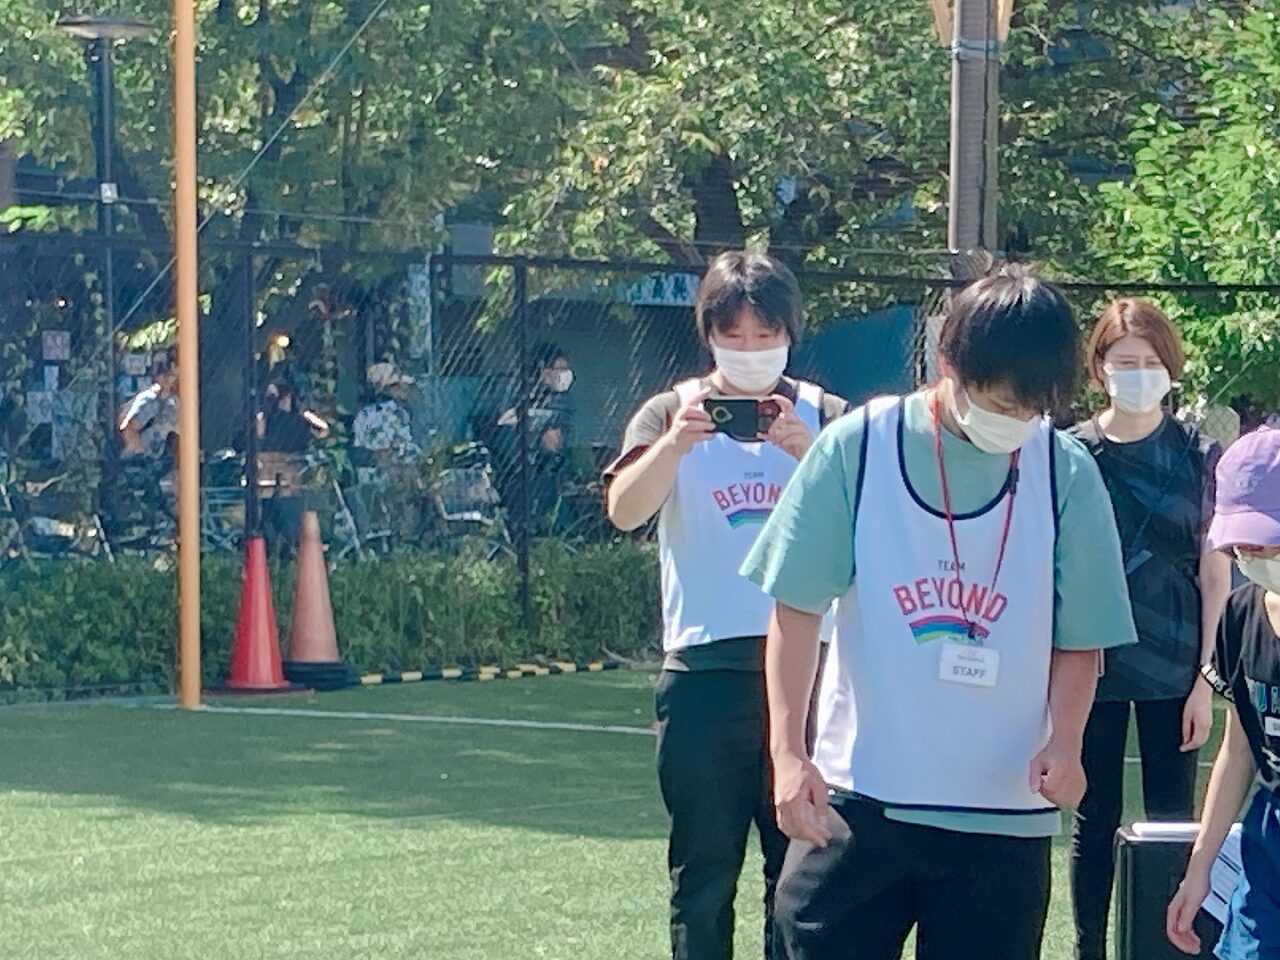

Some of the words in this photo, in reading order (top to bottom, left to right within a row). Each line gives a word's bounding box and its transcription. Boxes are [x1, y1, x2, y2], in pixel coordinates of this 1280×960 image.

[713, 482, 781, 511] BEYON
[938, 560, 965, 572] TEAM
[893, 577, 1008, 622] BEYOND
[953, 665, 986, 678] STAFF
